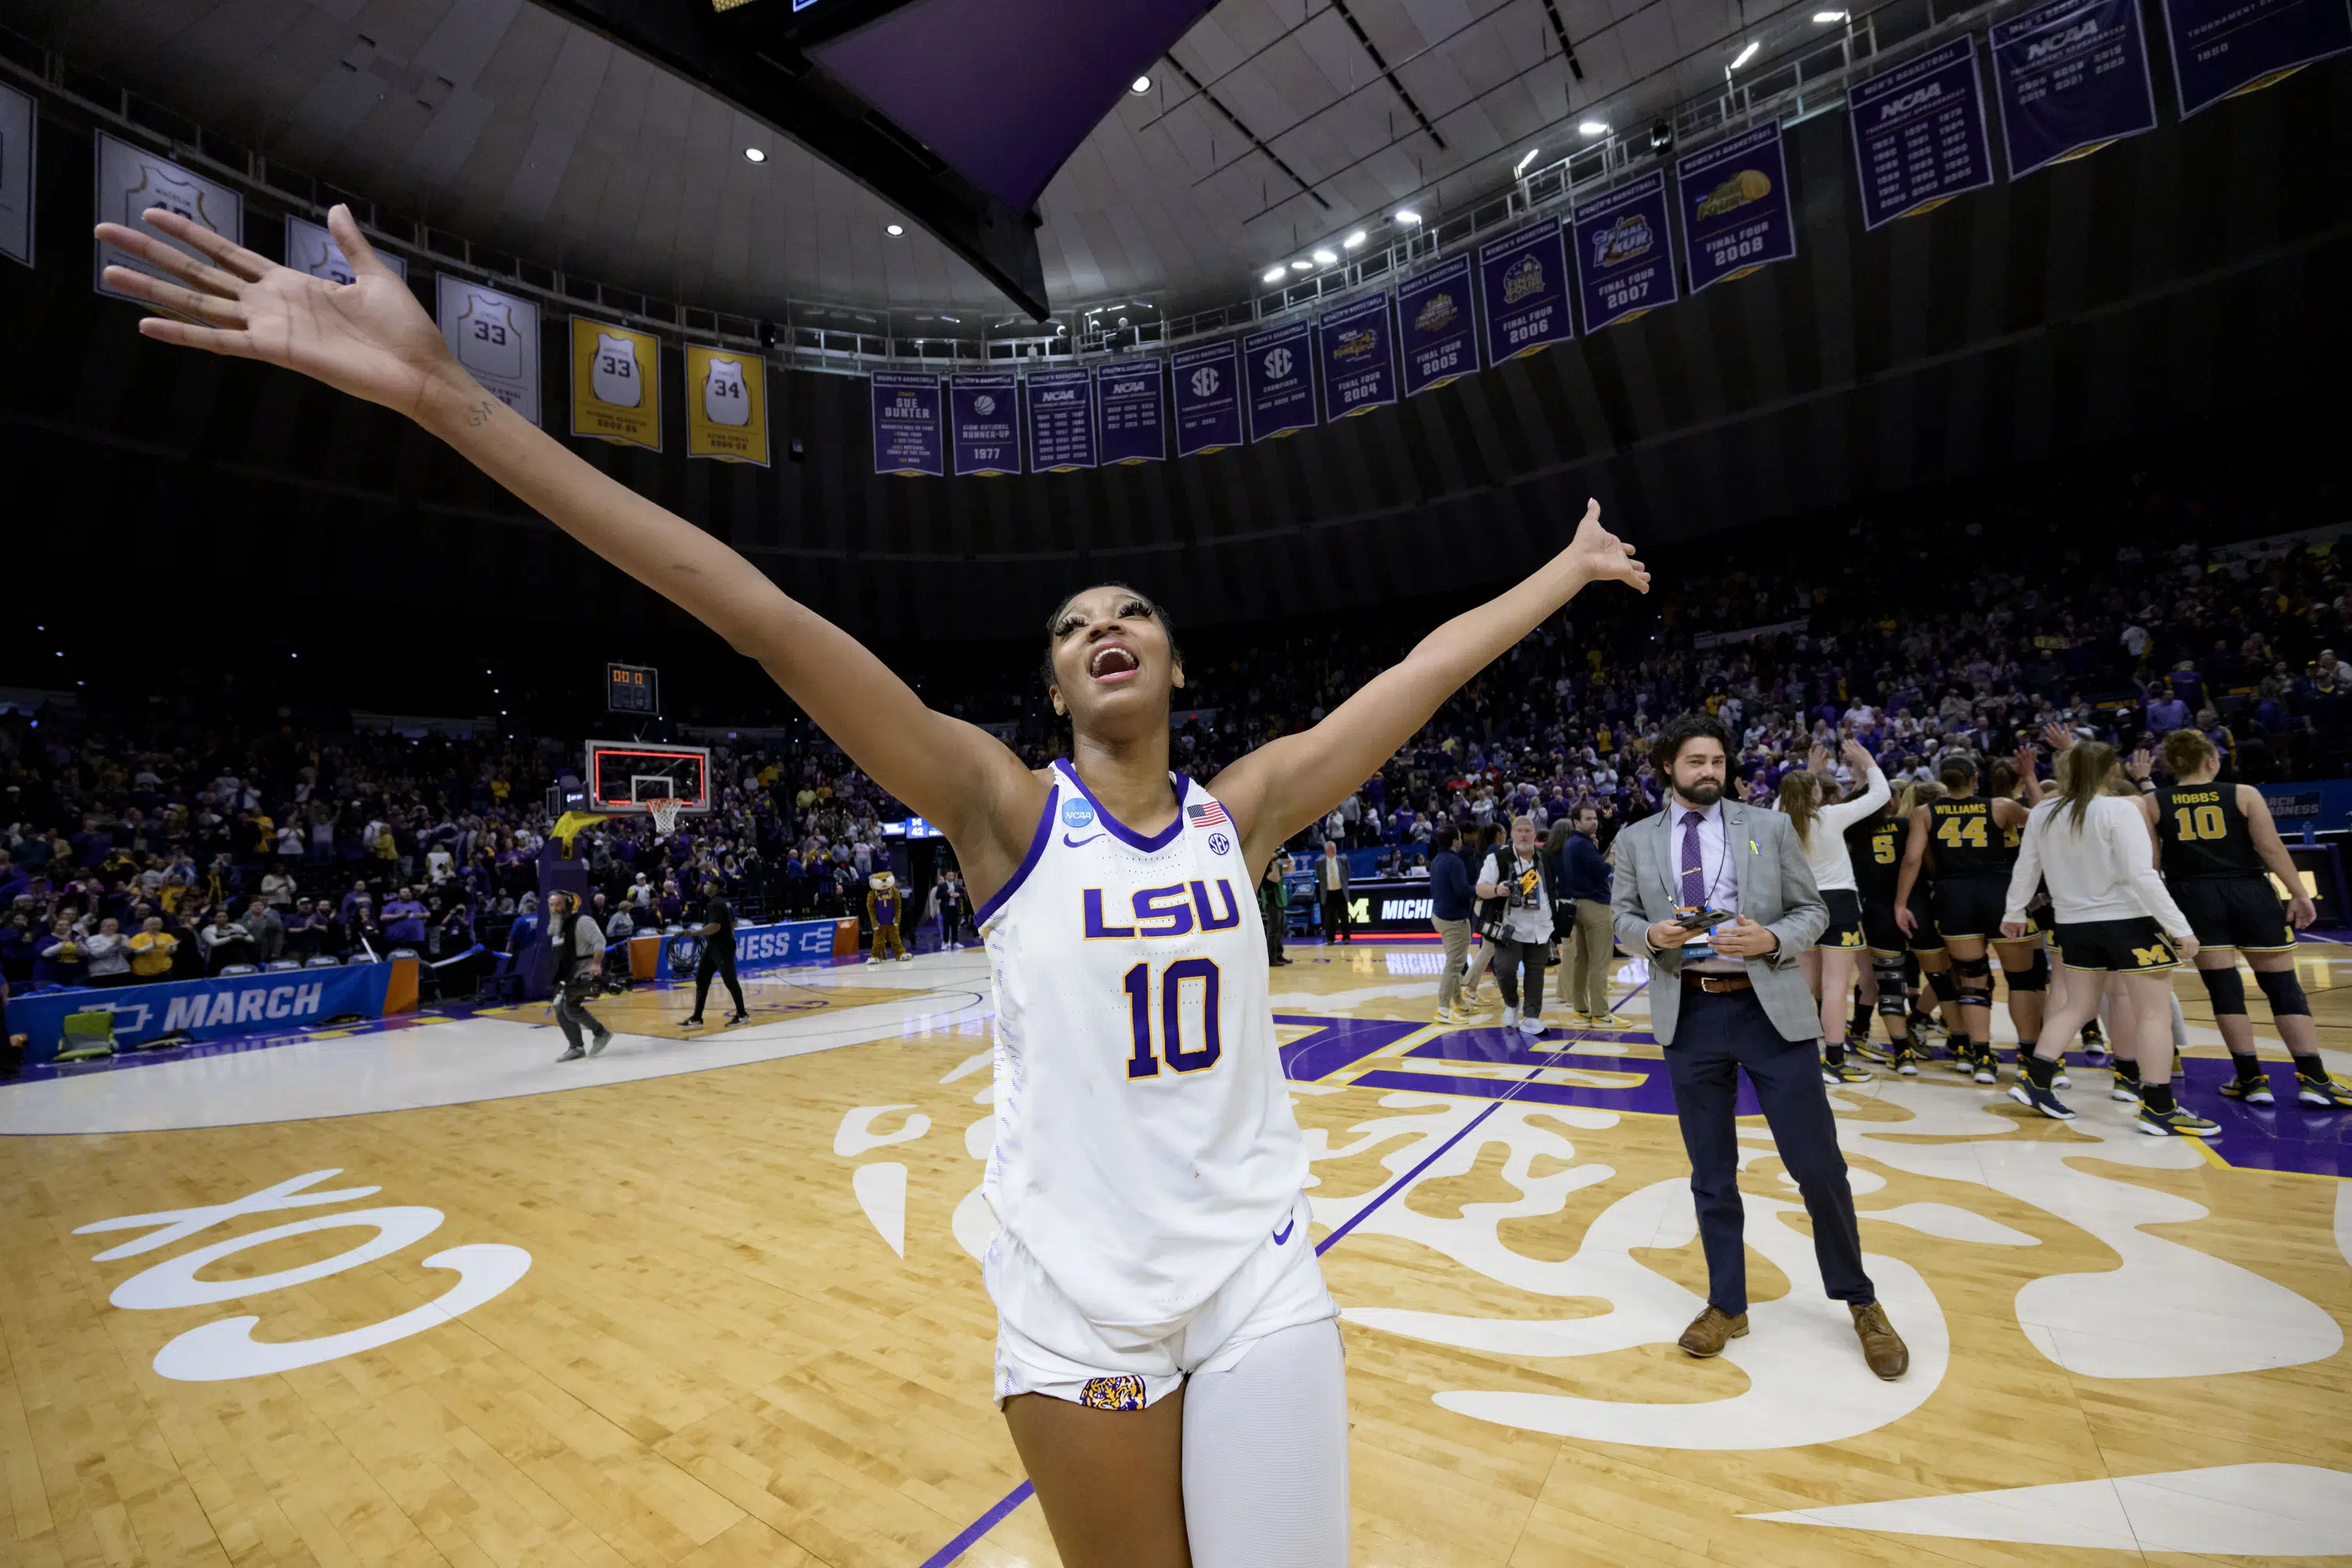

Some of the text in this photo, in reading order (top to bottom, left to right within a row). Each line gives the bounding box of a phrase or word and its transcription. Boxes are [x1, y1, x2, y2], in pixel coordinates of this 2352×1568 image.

[2026, 20, 2098, 59] NCAA
[1879, 82, 1942, 118] NCAA
[1722, 129, 1772, 154] BASKETBALL
[1706, 221, 1769, 253] FINAL FOUR
[1715, 236, 1763, 267] 2008
[1599, 267, 1654, 296] FINAL FOUR
[1607, 281, 1649, 309] 2007
[1503, 305, 1553, 332] FINAL FOUR
[474, 320, 506, 346] 33
[1509, 319, 1548, 344] 2006
[1264, 348, 1293, 379] SEC
[1417, 340, 1461, 364] FINAL FOUR
[602, 355, 631, 378] 33
[1423, 354, 1457, 376] 2005
[714, 379, 740, 398] 34
[1113, 381, 1145, 394] NCAA
[1191, 367, 1220, 397] SEC
[1263, 378, 1298, 393] CHAMPIONS
[1338, 372, 1381, 391] FINAL FOUR
[1344, 382, 1377, 403] 2004
[896, 397, 918, 408] SUE
[1042, 390, 1074, 401] NCAA
[884, 407, 930, 419] GUNTER
[963, 430, 1010, 439] RUNNER-UP
[974, 448, 1000, 460] 1977
[1934, 804, 1986, 815] WILLIAMS
[2172, 791, 2220, 804] HOBBS
[1065, 811, 1092, 820] NCAA
[2175, 805, 2227, 841] 10
[1210, 834, 1229, 855] SEC
[1937, 817, 1988, 848] 44
[1872, 835, 1896, 864] 5
[877, 892, 891, 901] LSU
[1081, 877, 1242, 941] LSU
[1841, 931, 1860, 946] M
[2132, 943, 2171, 967] M
[162, 982, 324, 1033] MARCH
[1122, 956, 1223, 1081] 10
